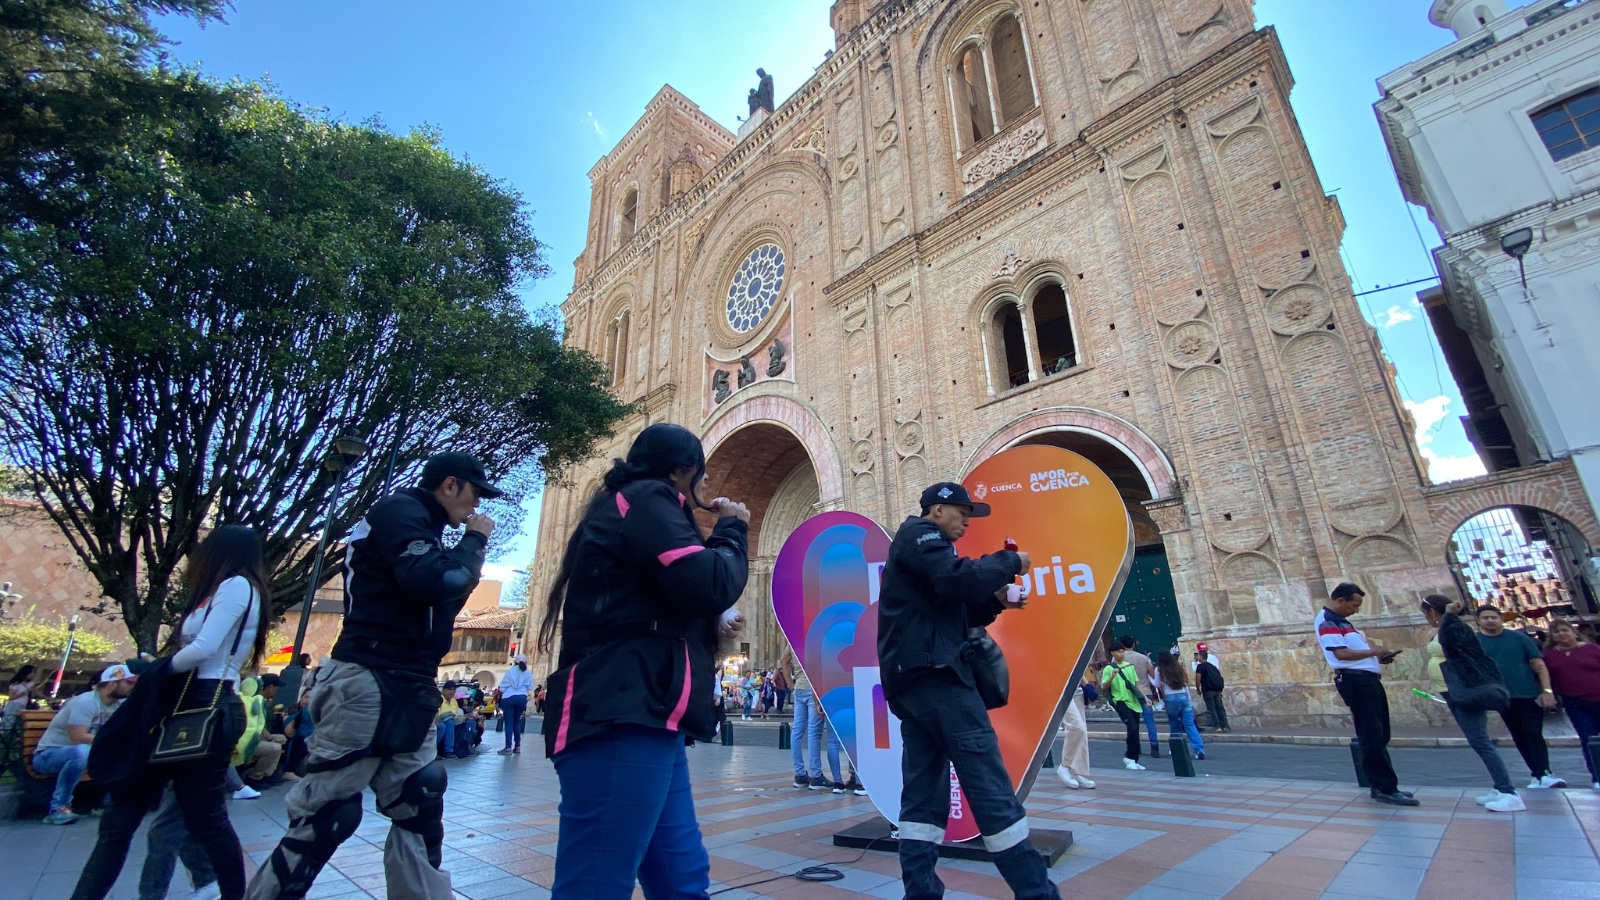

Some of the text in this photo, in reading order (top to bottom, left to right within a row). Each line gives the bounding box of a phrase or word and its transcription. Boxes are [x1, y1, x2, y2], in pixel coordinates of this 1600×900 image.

[1030, 468, 1066, 483] AMOR
[991, 482, 1023, 493] CUENCA
[1030, 475, 1090, 493] CUENCA
